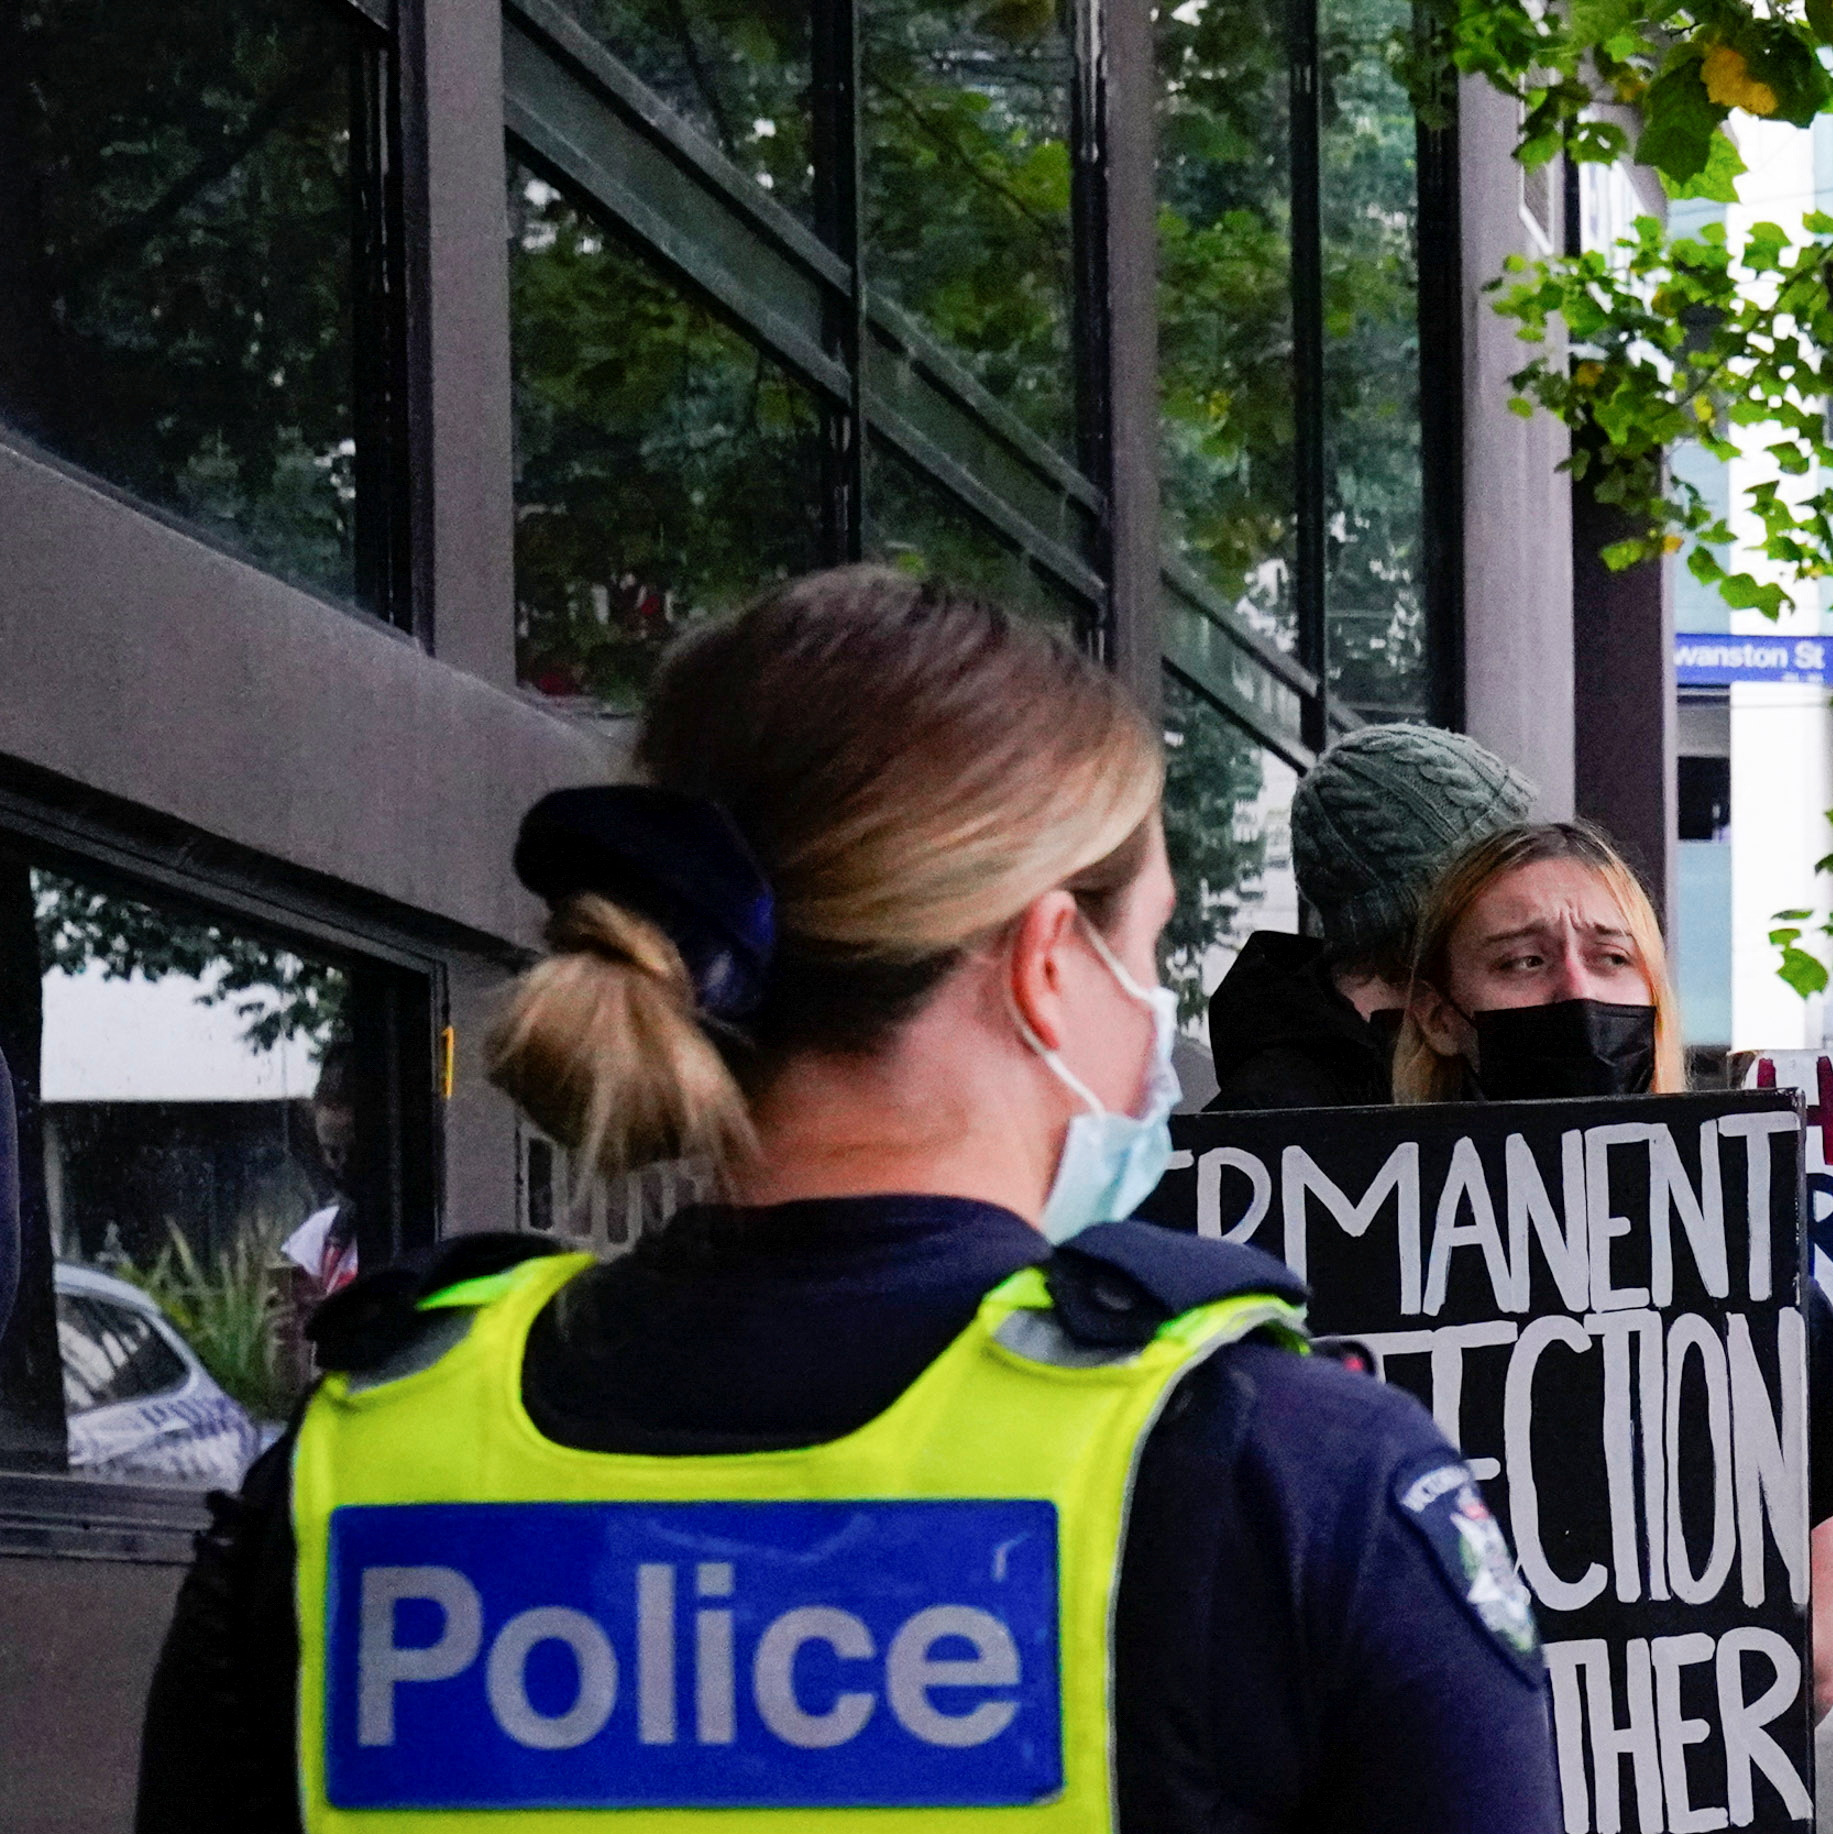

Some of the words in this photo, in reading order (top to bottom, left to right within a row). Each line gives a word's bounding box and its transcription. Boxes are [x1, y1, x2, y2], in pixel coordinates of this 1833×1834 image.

[1674, 643, 1788, 669] wanston
[1794, 640, 1826, 669] St
[1166, 1111, 1799, 1315] RMANENT
[357, 1562, 1022, 1750] Police
